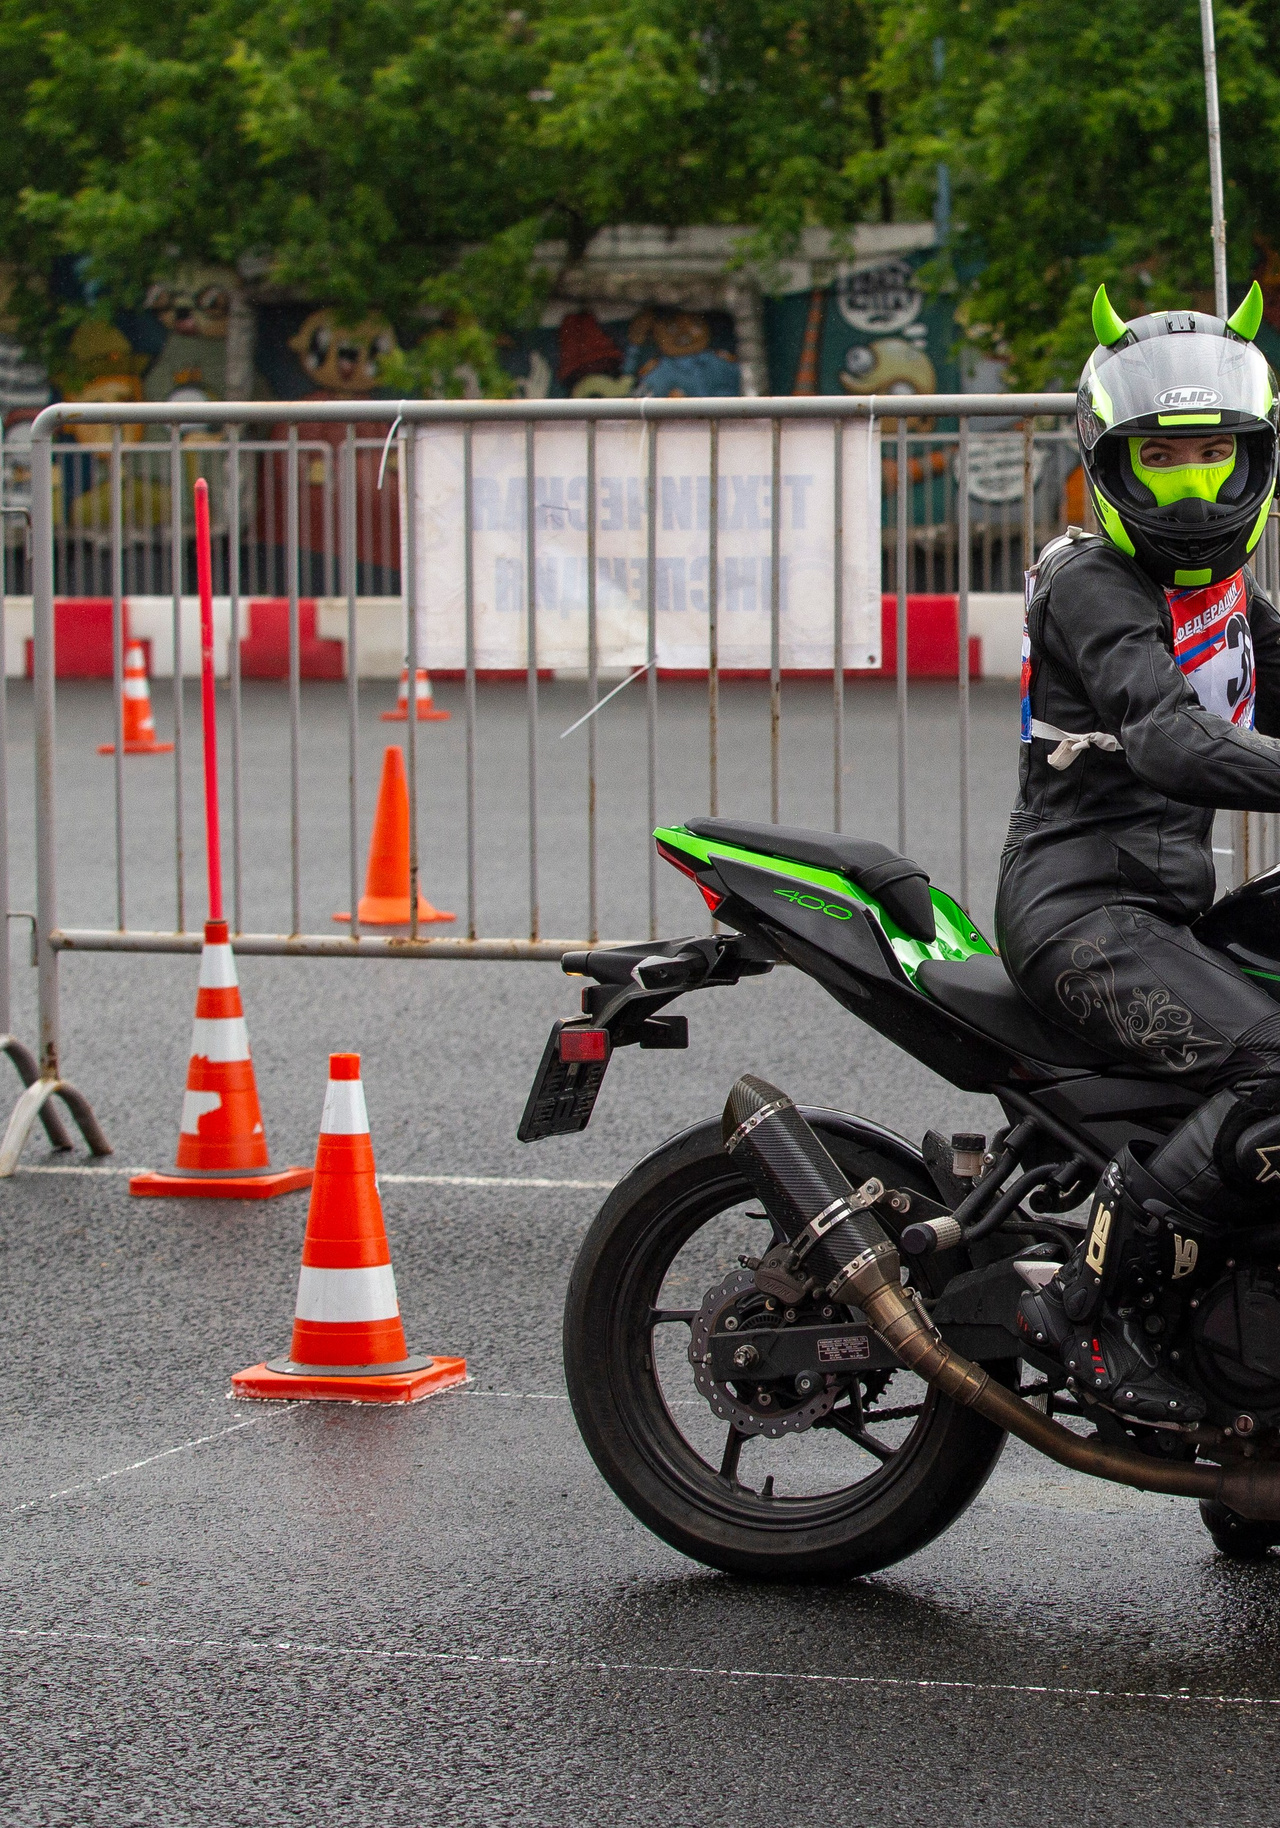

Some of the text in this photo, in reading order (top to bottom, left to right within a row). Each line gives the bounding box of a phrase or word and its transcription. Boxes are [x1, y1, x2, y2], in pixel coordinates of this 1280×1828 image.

[1163, 391, 1214, 404] HJC
[1176, 581, 1239, 641] ФЕДЕРАЦИЯ
[772, 888, 853, 921] 400
